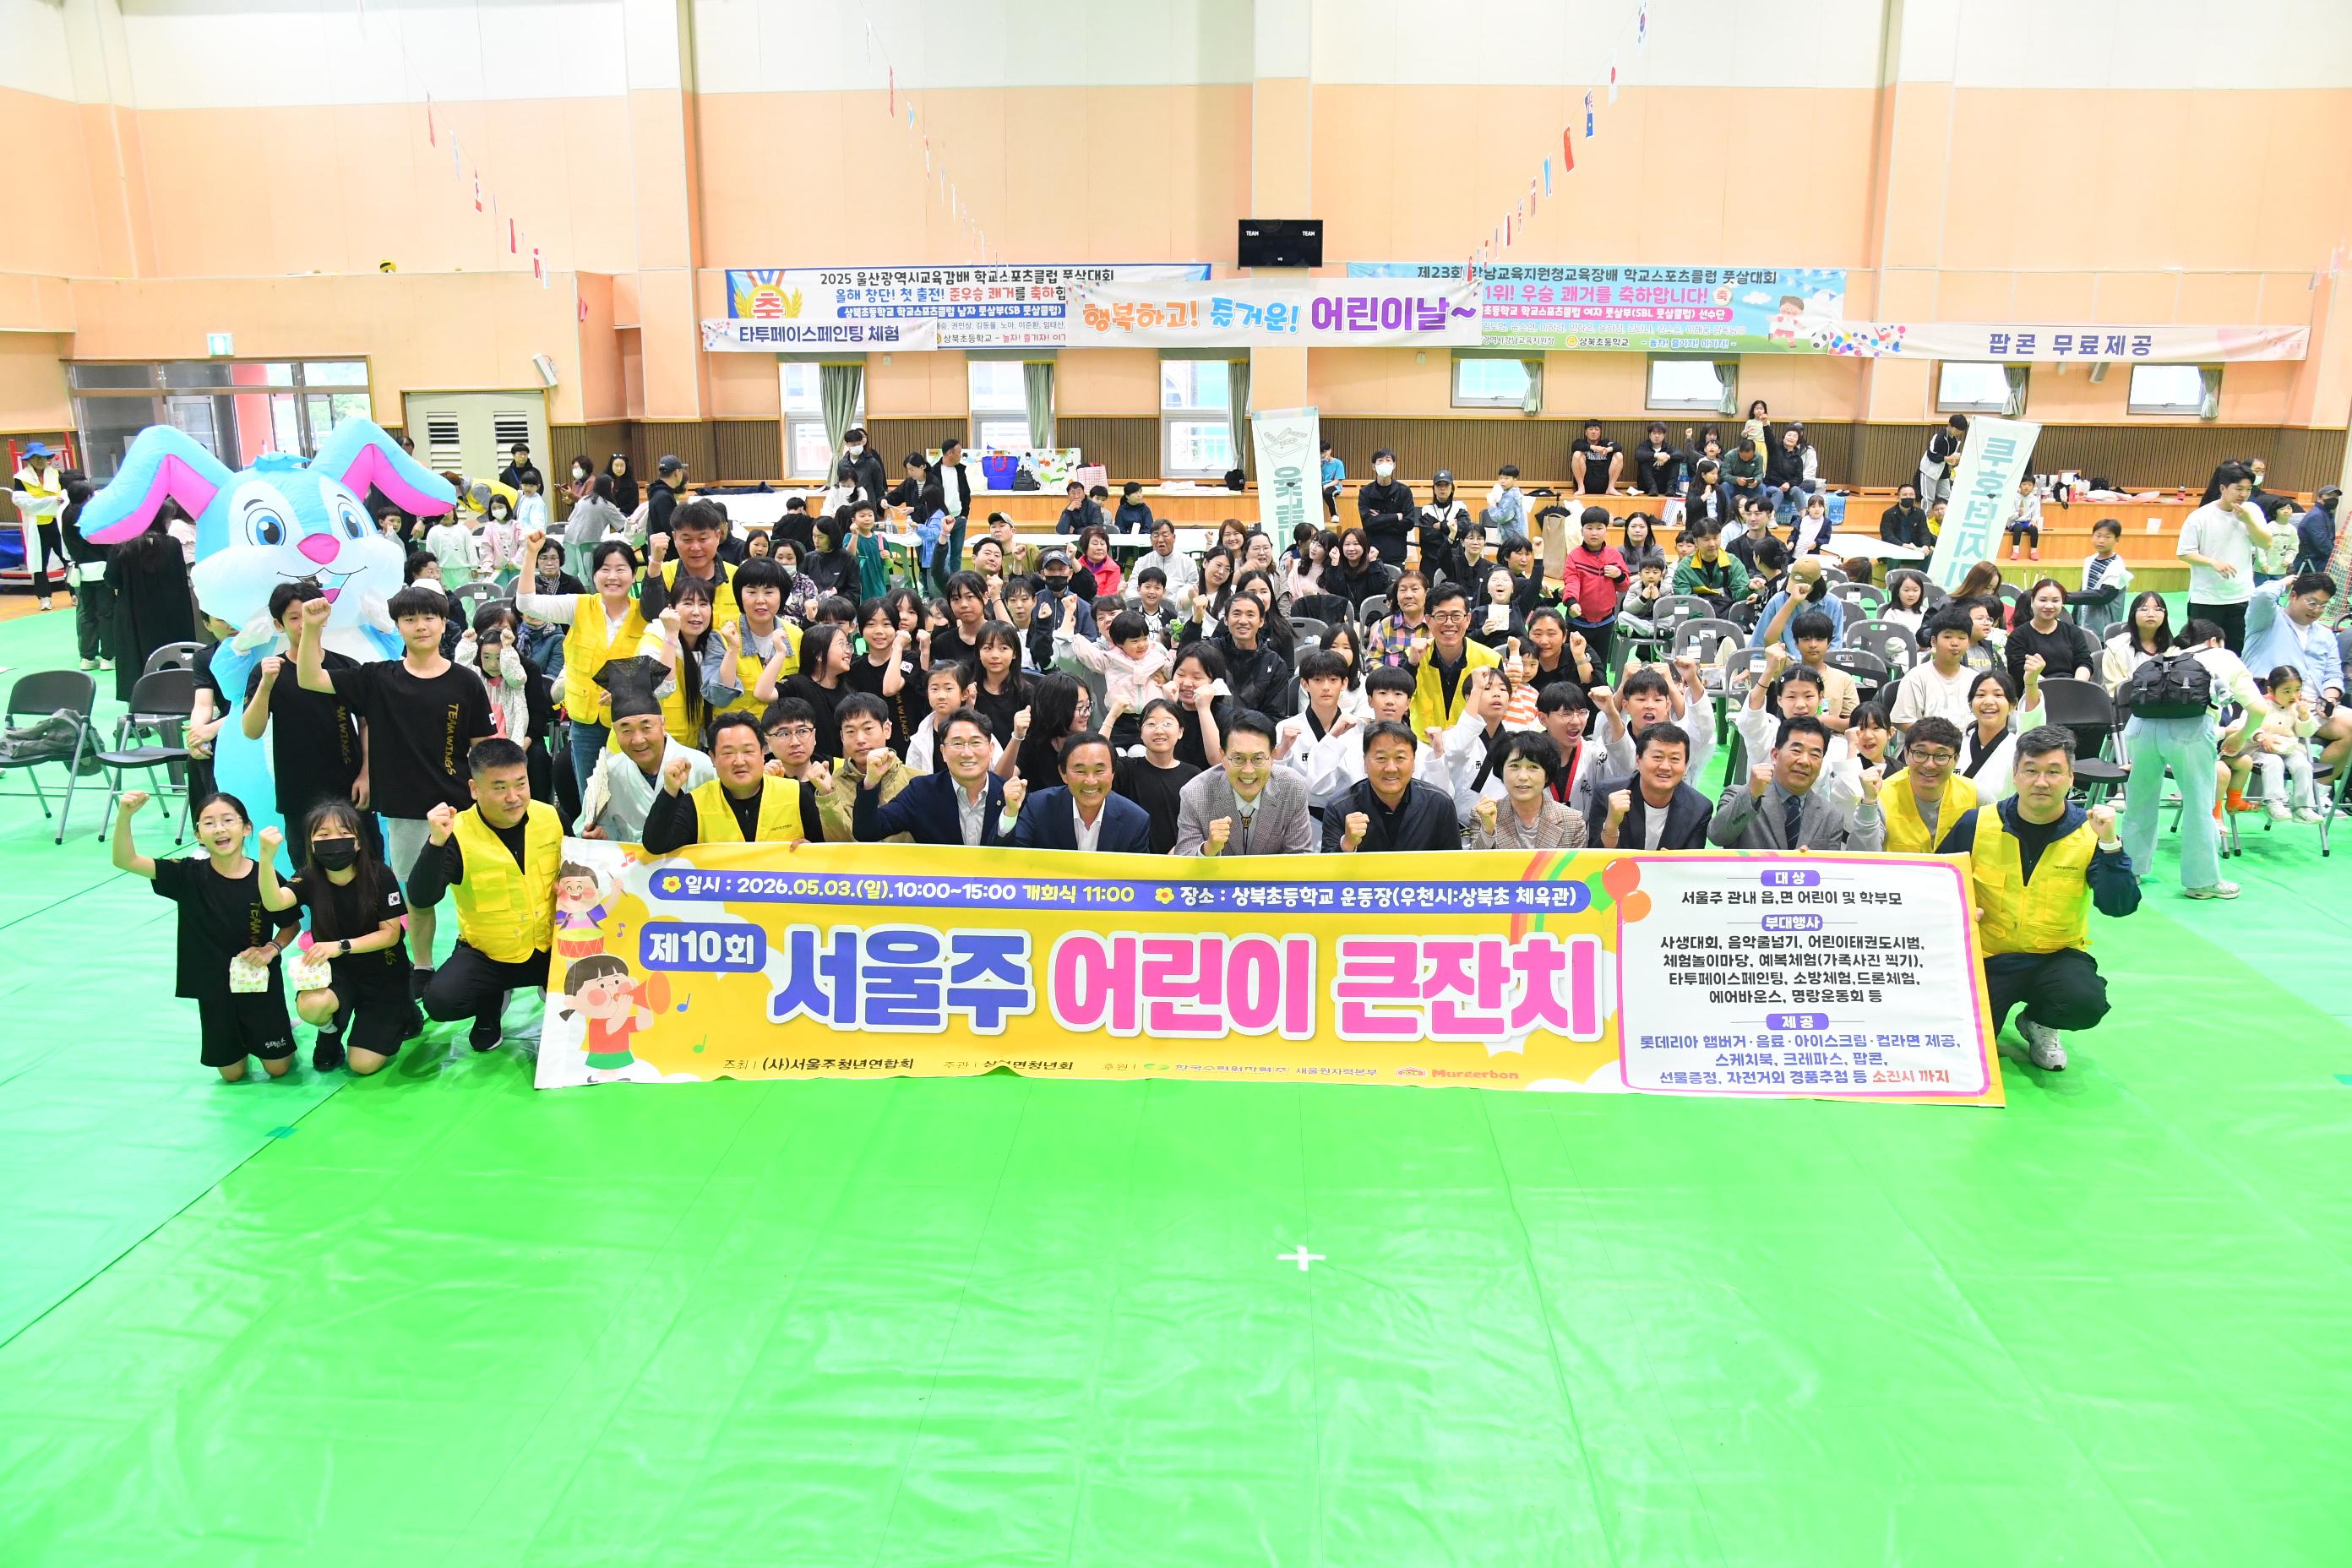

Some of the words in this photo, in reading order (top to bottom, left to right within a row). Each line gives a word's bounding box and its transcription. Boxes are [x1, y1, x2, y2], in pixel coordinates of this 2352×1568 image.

[820, 273, 852, 286] 2025
[857, 270, 970, 286] 울산광역시교육감배
[974, 270, 1059, 286] 학교스포츠클럽
[1417, 265, 1462, 280] 제23회
[1624, 270, 1718, 284] 학교스포츠클럽
[1723, 270, 1777, 285] 풋살대회
[836, 288, 861, 304] 올해
[865, 288, 896, 304] 창단!
[900, 287, 912, 302] 첫
[917, 287, 945, 302] 출전!
[950, 286, 983, 302] 준우승
[988, 286, 1026, 302] 쾌거를
[1485, 285, 1515, 302] 1위!
[1522, 285, 1554, 302] 우승
[1561, 285, 1611, 303] 쾌거를
[1619, 286, 1708, 304] 축하합니다!
[1716, 290, 1729, 302] 축
[843, 307, 894, 318] 상북초등학교
[897, 306, 956, 318] 학교스포츠클럽
[957, 306, 976, 317] 남자
[1023, 305, 1062, 317] 풋살클럽)
[1082, 301, 1200, 333] 행복하고!
[1209, 297, 1299, 334] 즐거운!
[1310, 296, 1478, 334] 어린이날~
[1484, 306, 1518, 317] 초등학교
[1521, 306, 1580, 318] 학교스포츠클럽
[1584, 307, 1603, 318] 여자
[1606, 307, 1653, 318] 풋살부(SBL
[1656, 308, 1696, 320] 풋살클럽)
[1699, 308, 1726, 320] 선수단
[739, 326, 864, 343] 타투페이스페인팅
[868, 325, 900, 342] 체험
[943, 333, 993, 344] 상북초등학교
[1003, 334, 1021, 343] 놀자!
[1024, 334, 1049, 343] 즐기자!
[1579, 337, 1629, 347] 상북초등학교
[1649, 338, 1669, 348] 놀자!
[1671, 339, 1699, 348] 즐기자!
[1701, 340, 1729, 348] 이기자!
[1988, 332, 2037, 355] 팝콘
[2052, 334, 2153, 357] 무료제공
[446, 703, 460, 734] TEAM
[339, 723, 351, 765] WINGS
[444, 735, 457, 776] WINGS
[684, 876, 721, 894] 일시
[1025, 883, 1077, 903] 개회식
[1083, 887, 1135, 903] 11:00
[1179, 887, 1214, 906] 장소
[1231, 887, 1334, 906] 상북초등학교
[1340, 885, 1511, 907] 운동장(우천시:상북초
[1516, 886, 1577, 908] 체육관)
[1681, 891, 1723, 906] 서울주
[1727, 890, 1756, 906] 관내
[1761, 890, 1793, 906] 읍,면
[1797, 891, 1838, 905] 어린이
[1842, 891, 1855, 906] 및
[1859, 891, 1903, 906] 학부모
[248, 901, 262, 934] TEAM
[1765, 916, 1821, 930] 부대행사
[648, 930, 754, 966] 제10회
[1660, 936, 1723, 950] 사생대회,
[1728, 935, 1803, 950] 음악줄넘기,
[1808, 935, 1925, 950] 어린이태권도시범,
[1663, 954, 1754, 969] 체험놀이마당,
[1759, 954, 1882, 969] 예복체험(가족사진
[1885, 953, 1924, 969] 찍기),
[771, 928, 1029, 1028] 서울주
[1053, 936, 1310, 1034] 어린이
[1337, 939, 1597, 1036] 큰잔치
[1669, 972, 1788, 987] 타투페이스페인팅,
[1793, 971, 1921, 987] 소방체험,드론체험,
[1709, 989, 1787, 1004] 에어바운스,
[1792, 988, 1864, 1004] 명랑운동회
[1868, 988, 1882, 1004] 등
[1640, 1034, 1698, 1049] 롯데리아
[1925, 1033, 1962, 1049] 제공,
[723, 1059, 749, 1070] 주최
[762, 1057, 914, 1070] (사)서울주청년연합회
[944, 1060, 970, 1069] 주관
[1715, 1052, 1778, 1068] 스케치북,
[1783, 1052, 1848, 1067] 크레파스,
[1853, 1052, 1888, 1067] 팝콘,
[1102, 1063, 1128, 1071] 후원
[1296, 1067, 1378, 1076] 새울원자력본부
[1660, 1070, 1722, 1086] 선물증정,
[1727, 1070, 1785, 1085] 자전거외
[1789, 1070, 1848, 1085] 경품추첨
[1853, 1070, 1867, 1085] 등
[1872, 1069, 1915, 1084] 소진시
[1919, 1069, 1950, 1085] 까지
